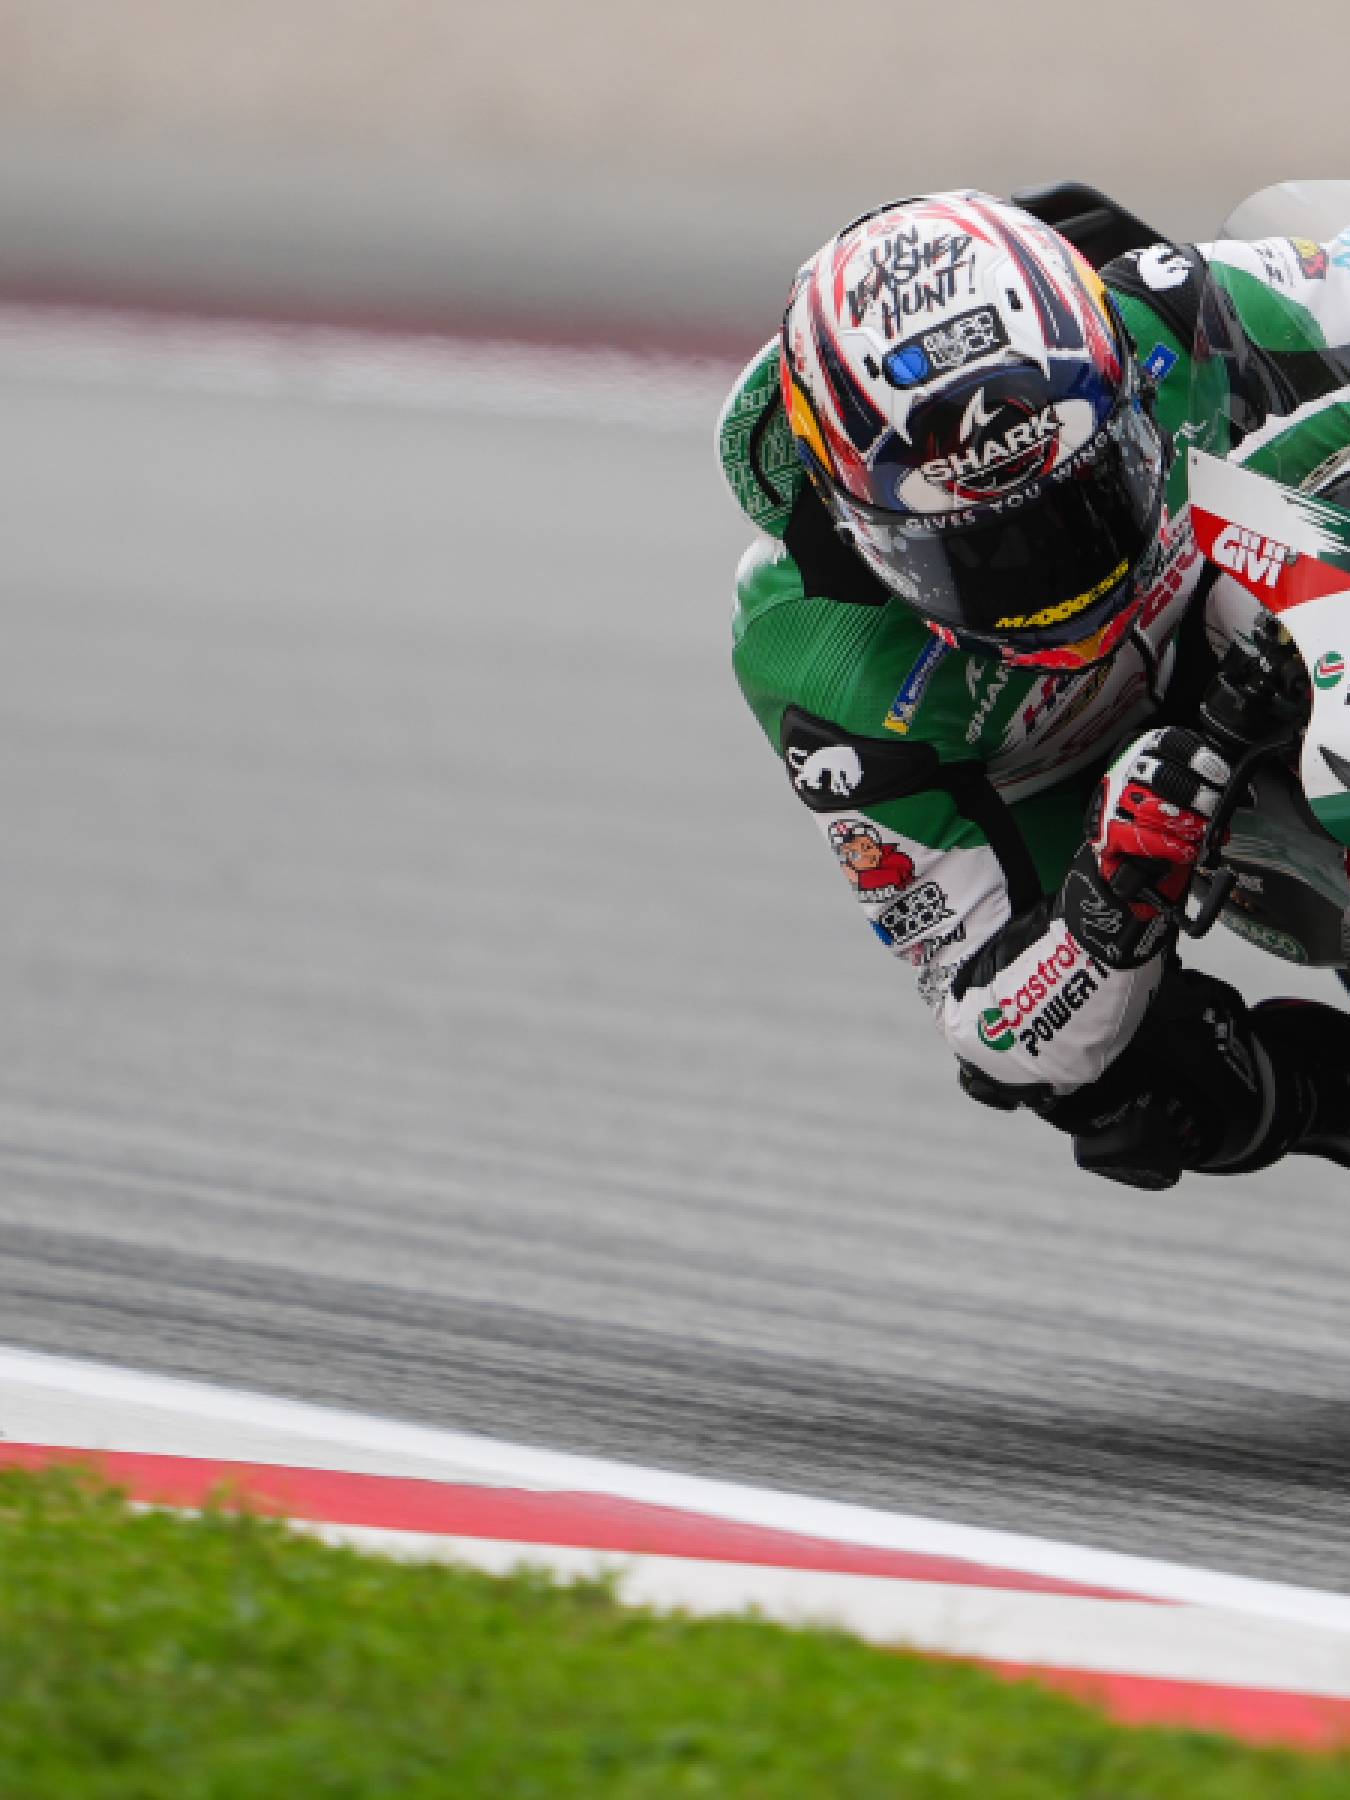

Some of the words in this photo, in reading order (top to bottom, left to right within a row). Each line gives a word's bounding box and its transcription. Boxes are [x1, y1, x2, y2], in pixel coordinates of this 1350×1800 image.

[880, 251, 977, 340] HUNT!
[920, 405, 1060, 484] SHARK
[904, 509, 976, 530] GIVES
[989, 484, 1042, 513] YOU
[1211, 523, 1284, 589] GIVI
[966, 662, 1009, 745] SHAR
[1000, 931, 1084, 1029] Castrol
